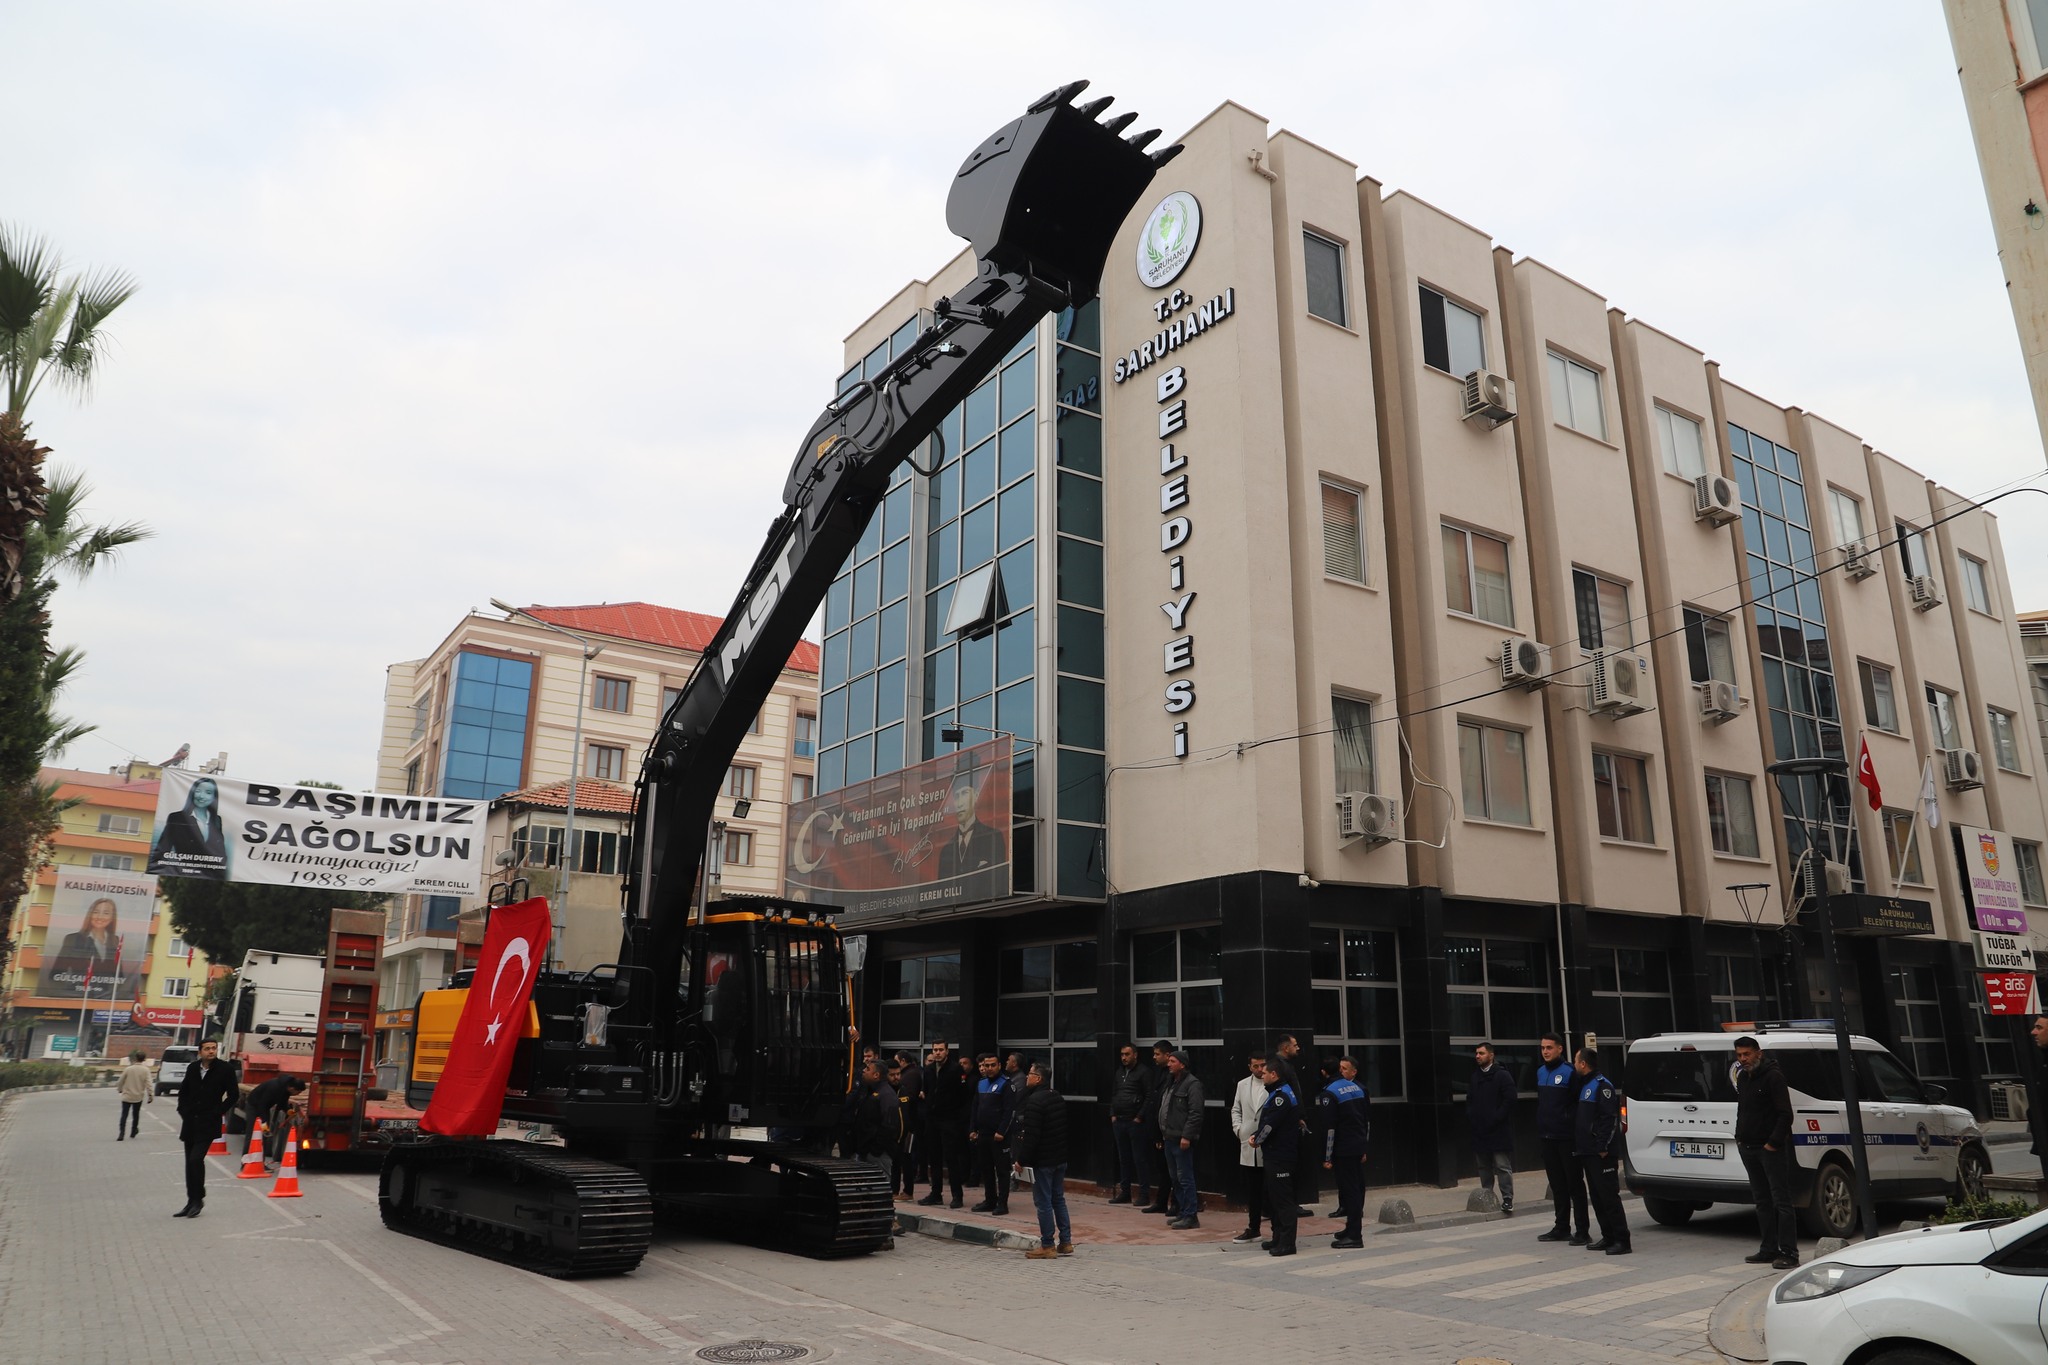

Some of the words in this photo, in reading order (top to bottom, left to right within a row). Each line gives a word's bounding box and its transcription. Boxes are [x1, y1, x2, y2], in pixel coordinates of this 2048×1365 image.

[1148, 245, 1188, 278] SARUHANLI
[1153, 288, 1193, 322] T.C.
[1113, 287, 1235, 384] SARUHANLI
[1157, 365, 1197, 758] BELEDİYESİ
[720, 531, 796, 685] MST
[245, 783, 474, 824] BAŞIMIZ
[886, 800, 897, 814] En
[900, 795, 916, 814] Çok
[918, 788, 945, 806] Seven
[843, 824, 875, 845] Görevini
[877, 824, 887, 837] En
[889, 818, 901, 838] İyi
[241, 819, 471, 860] SAĞOLSUN
[163, 851, 193, 861] GÜLŞAH
[193, 854, 224, 863] DURBAY
[247, 846, 419, 874] Unutmayacağız!
[64, 881, 148, 896] KALBİMİZDESİN
[414, 878, 445, 887] EKREM
[859, 899, 887, 912] BELEDİYE
[887, 894, 915, 909] BAŞKANI
[919, 888, 942, 902] EKREM
[1879, 908, 1915, 919] SARUHANLI
[1982, 914, 2004, 926] 100m.
[1863, 916, 1894, 927] BELEDİYE
[1895, 920, 1933, 931] BAŞKANLIĞI
[1986, 936, 2017, 950] TUĞBA
[1986, 953, 2023, 966] KUAFÖR
[2004, 978, 2026, 991] aras
[1807, 1135, 1819, 1143] ALO
[1863, 1135, 1883, 1144] ABITA
[1675, 1143, 1685, 1153] 45
[1690, 1144, 1700, 1153] HA
[1706, 1145, 1722, 1155] 641
